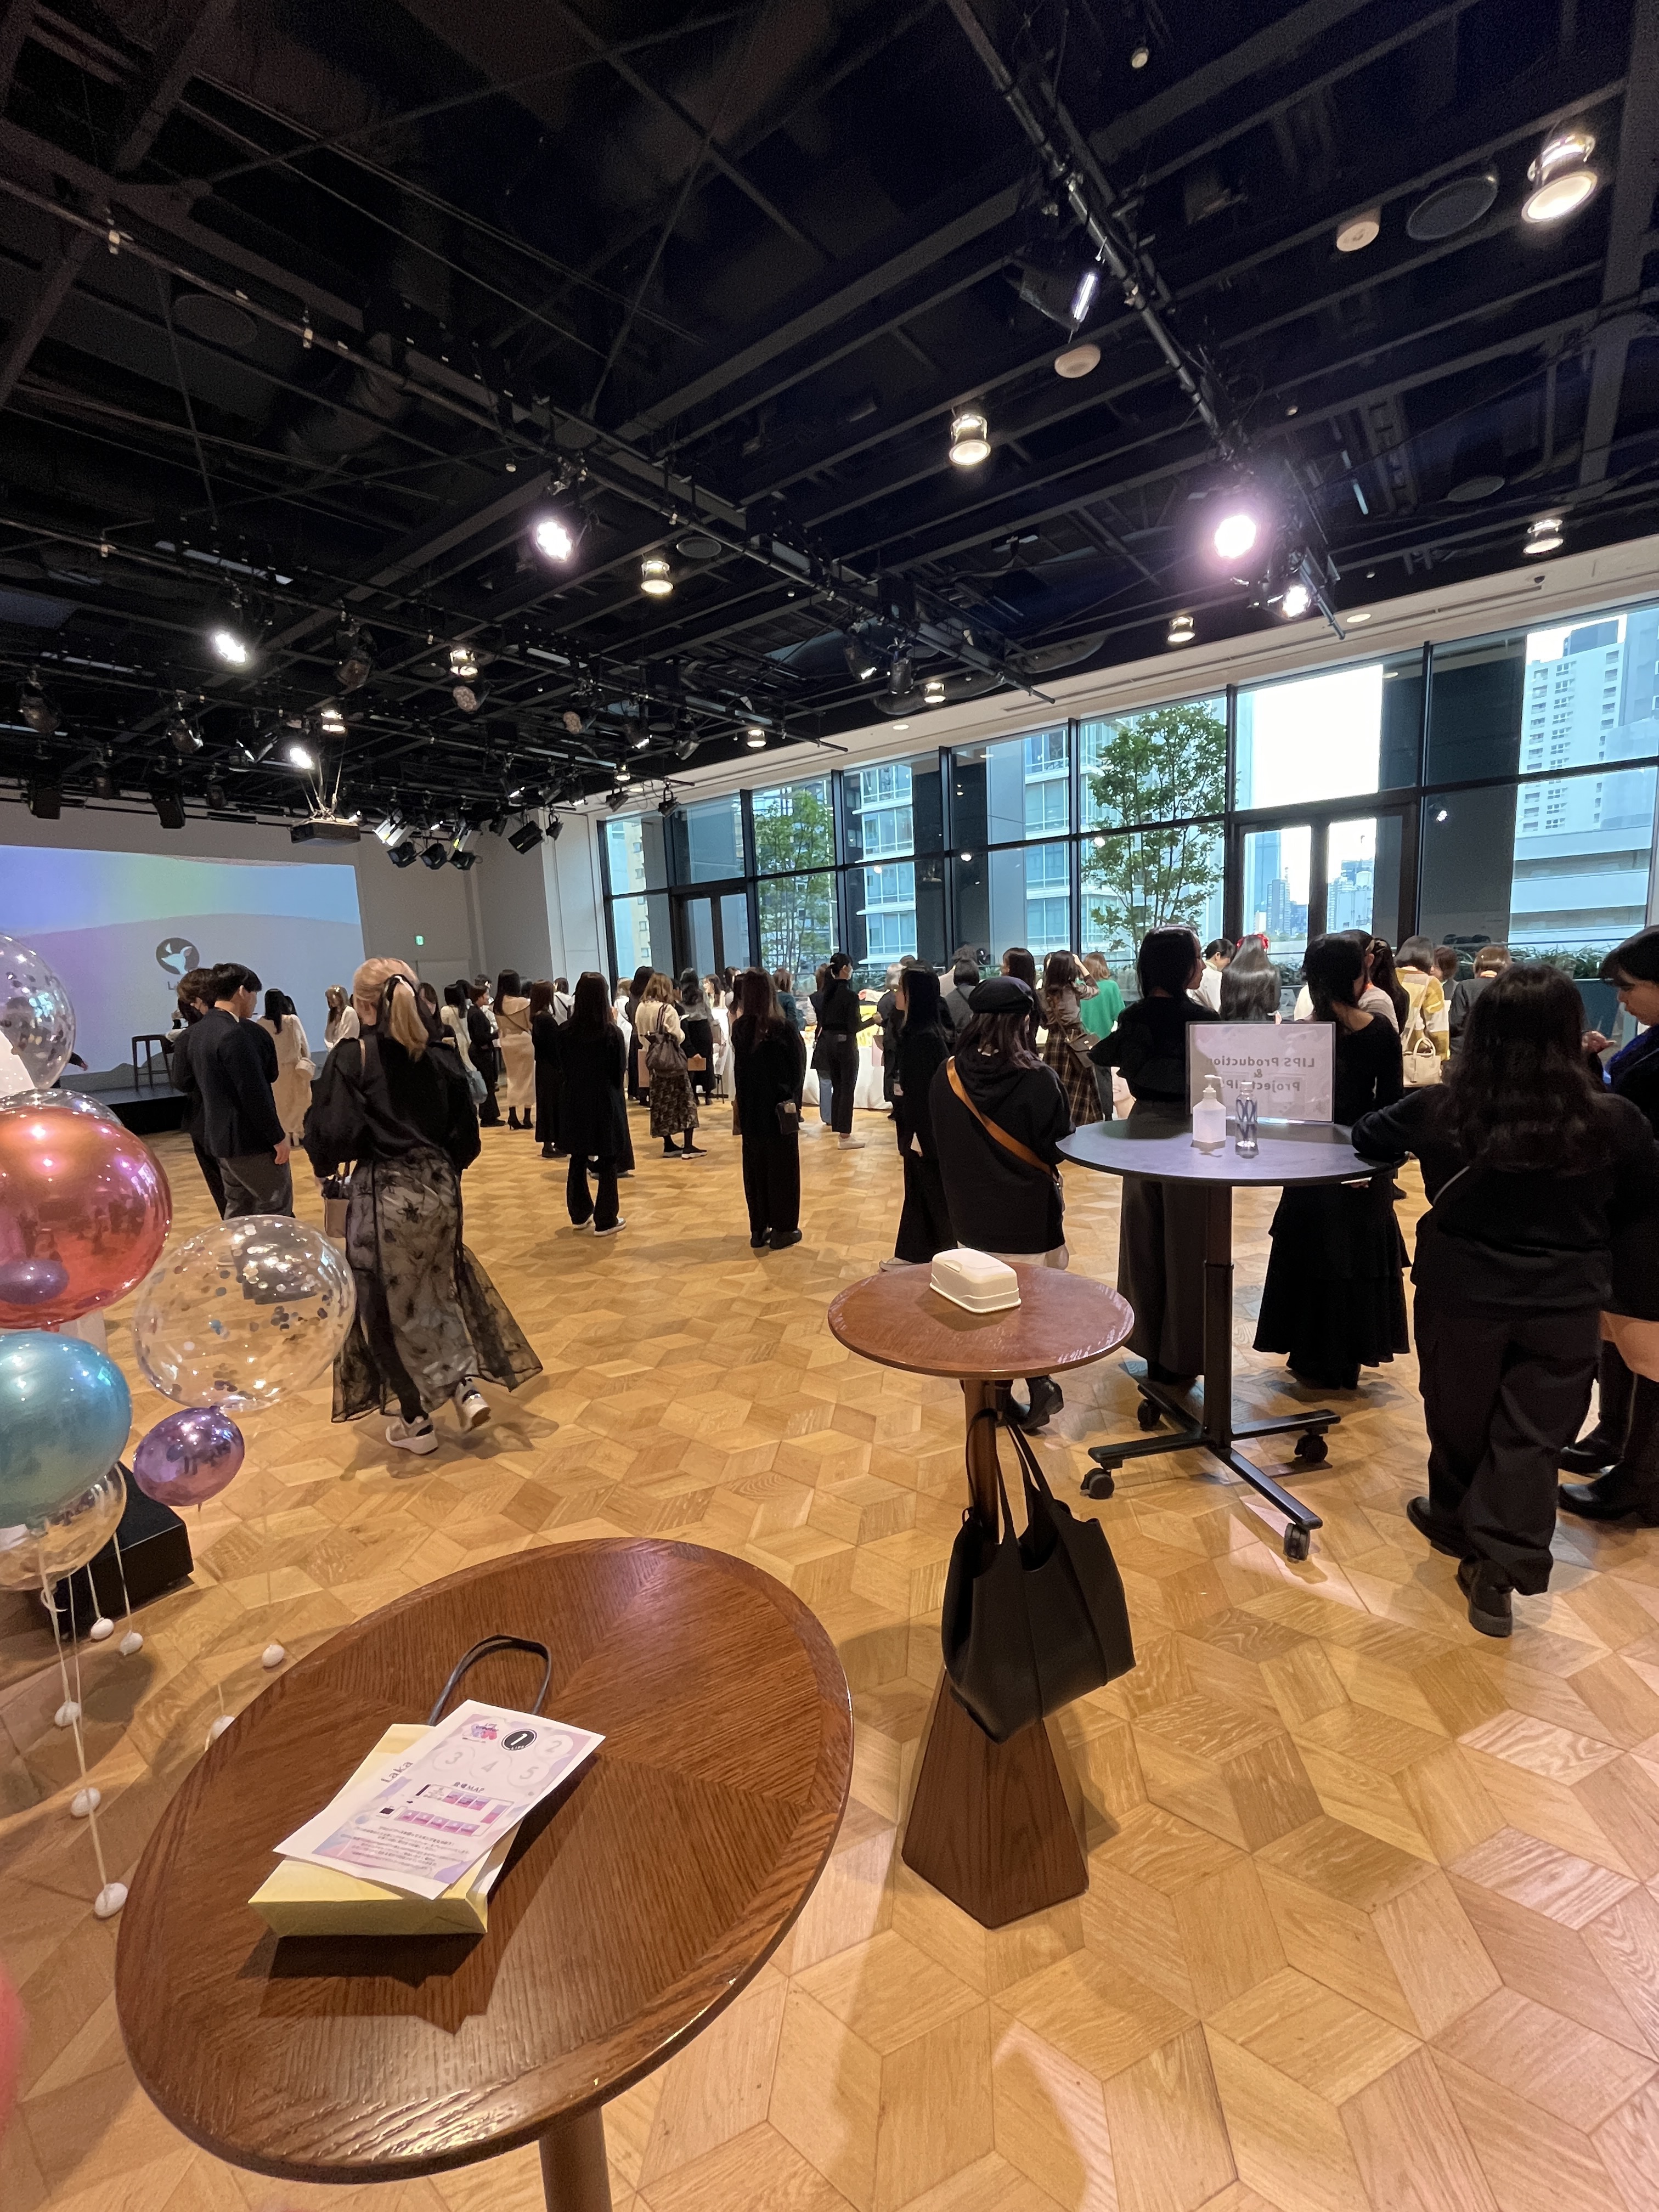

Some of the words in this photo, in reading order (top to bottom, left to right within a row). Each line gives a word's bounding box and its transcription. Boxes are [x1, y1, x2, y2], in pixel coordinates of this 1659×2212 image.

[510, 1733, 528, 1746] 1
[546, 1740, 562, 1753] 2
[445, 1752, 463, 1764] 3
[380, 1762, 413, 1783] Laka
[481, 1760, 499, 1773] 4
[519, 1766, 539, 1779] 5
